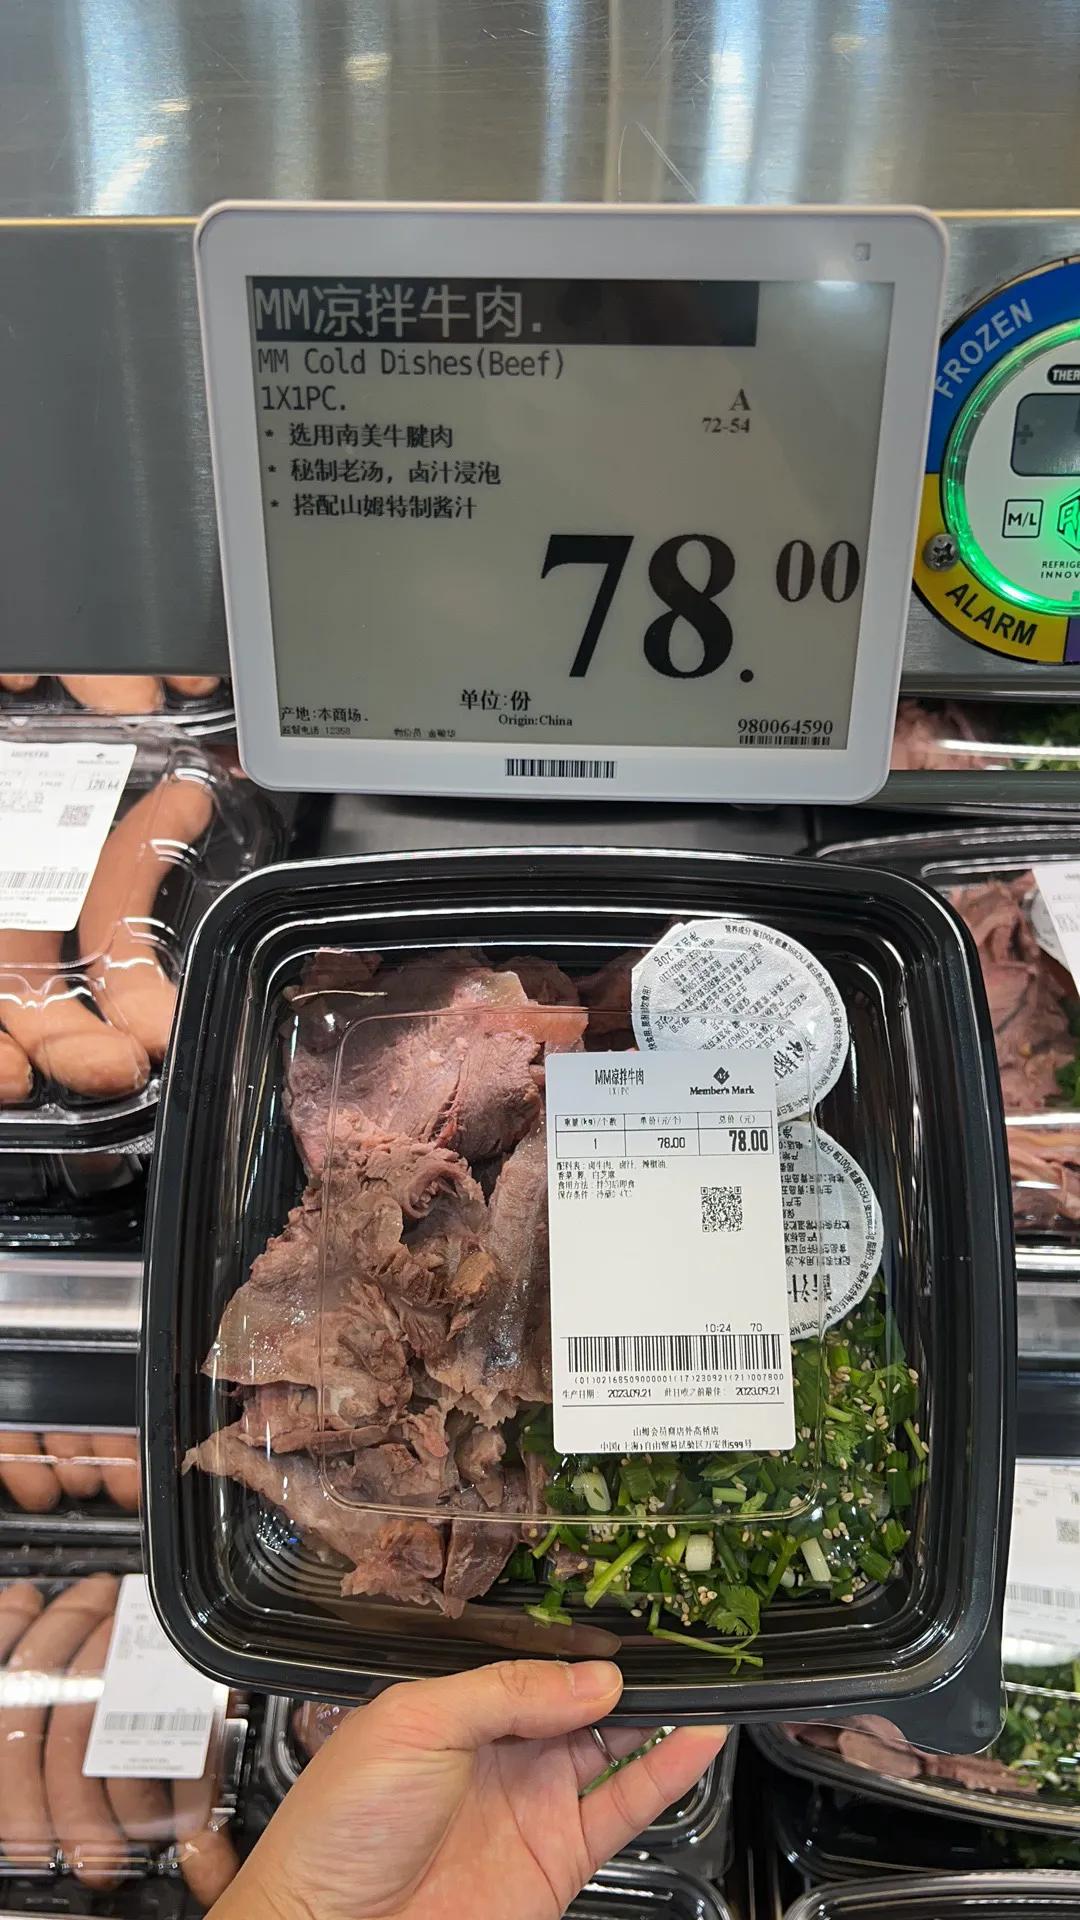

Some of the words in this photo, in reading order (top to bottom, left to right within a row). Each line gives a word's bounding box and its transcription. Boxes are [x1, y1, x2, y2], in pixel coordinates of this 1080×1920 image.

[255, 283, 541, 338] MM凉拌牛肉.
[934, 298, 1034, 399] FROZEN
[258, 349, 289, 374] MM
[304, 348, 365, 375] Cold
[381, 348, 565, 380] Dishes(Beef)
[260, 385, 347, 412] 1X1PC.
[729, 388, 751, 411] A
[289, 422, 453, 449] 选用南美牛腱肉
[702, 418, 750, 434] 72-54
[294, 494, 477, 519] 搭配山姆特制酱汁
[1007, 512, 1037, 527] M/L
[945, 583, 1038, 646] ALARM
[460, 689, 532, 711] 单位:份
[498, 714, 573, 727] Origin:China
[737, 719, 833, 735] 980064590
[594, 1067, 644, 1086] MM凉拌牛肉
[690, 1086, 729, 1096] Member's
[732, 1085, 755, 1095] Mark
[592, 1138, 598, 1150] 1
[657, 1137, 686, 1149] 78.00
[729, 1130, 768, 1152] 78.00
[705, 1323, 731, 1333] 10:24
[750, 1323, 763, 1332] 70
